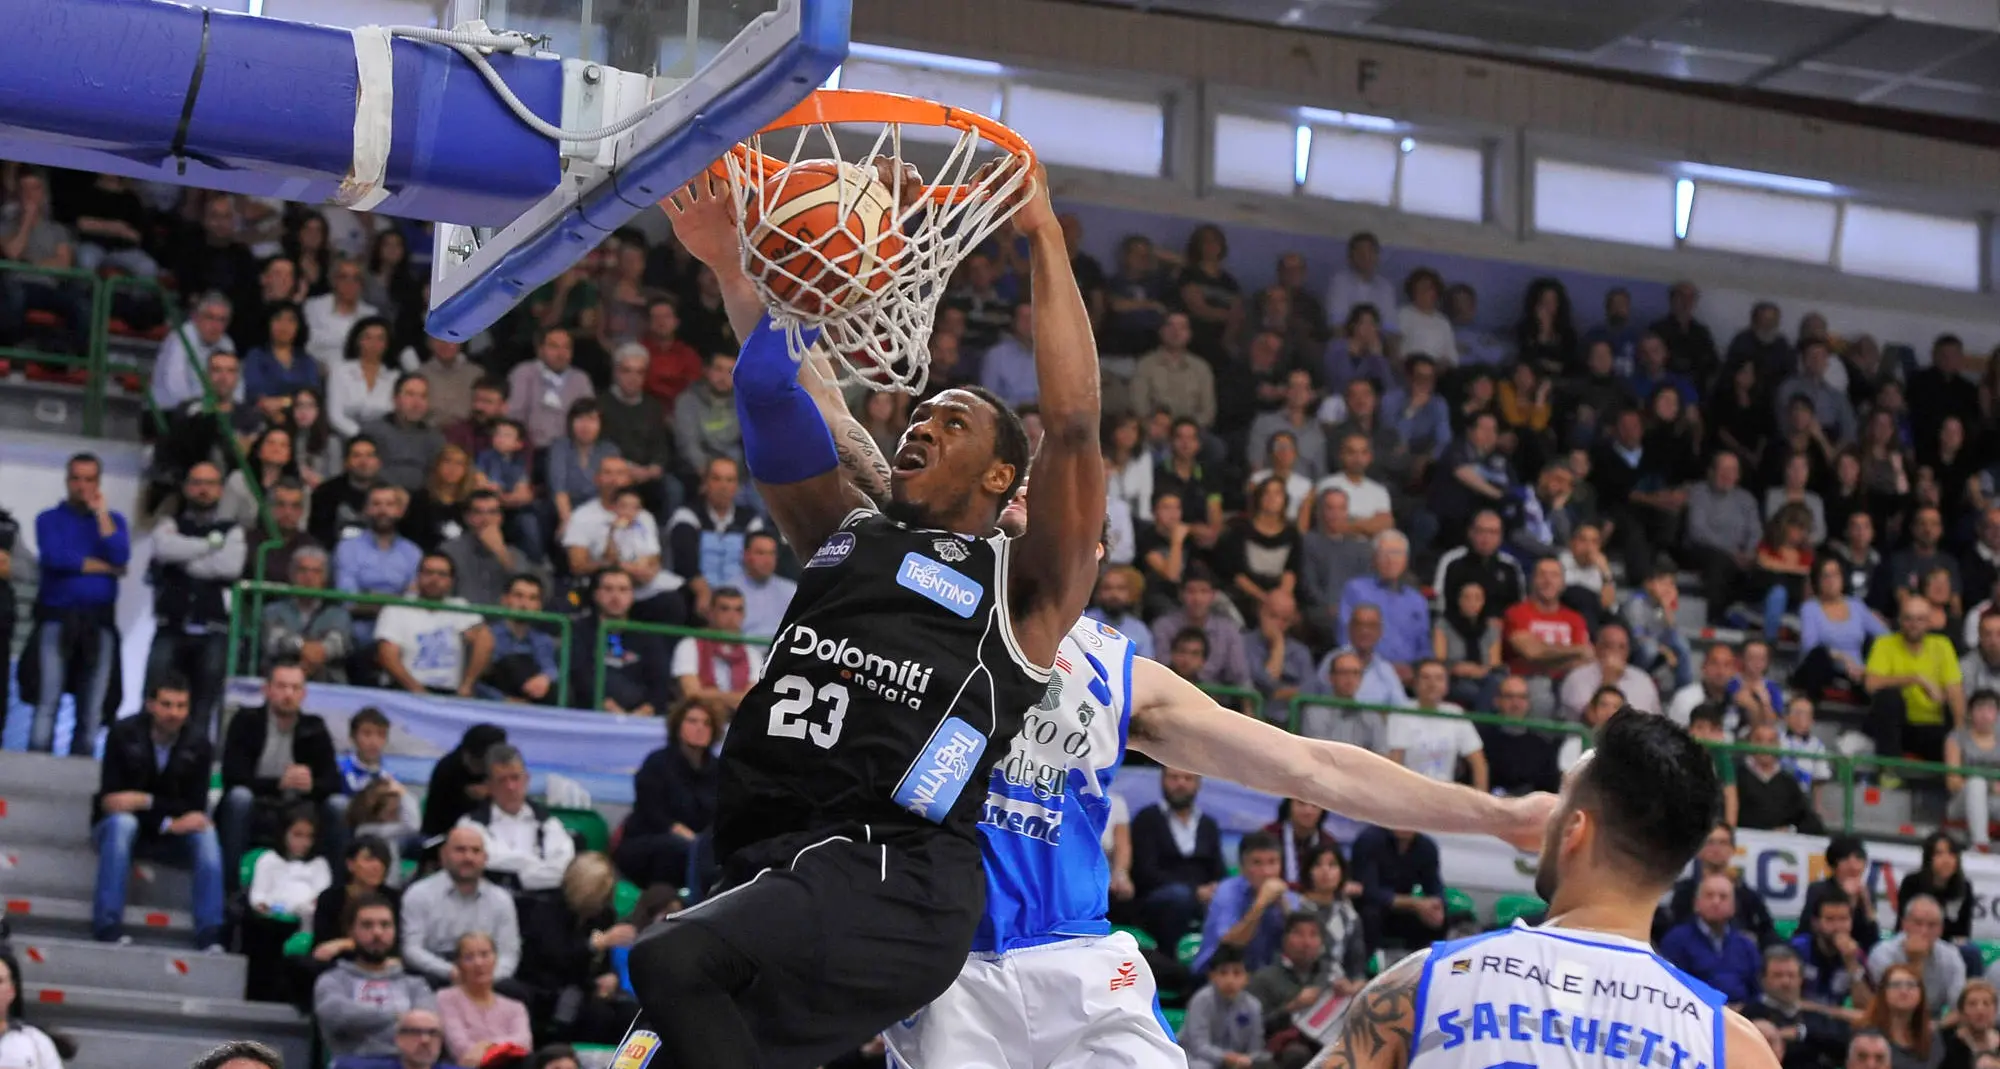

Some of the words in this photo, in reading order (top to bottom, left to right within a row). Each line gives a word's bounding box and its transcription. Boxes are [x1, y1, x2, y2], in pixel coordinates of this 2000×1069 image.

[906, 560, 976, 606] TRENTINO
[790, 625, 934, 693] Dolomiti
[767, 674, 850, 750] 23
[907, 731, 980, 818] TRENTIN
[1481, 955, 1584, 995] REALE
[1593, 979, 1701, 1024] MUTUA
[1438, 1002, 1707, 1069] SACCHETT
